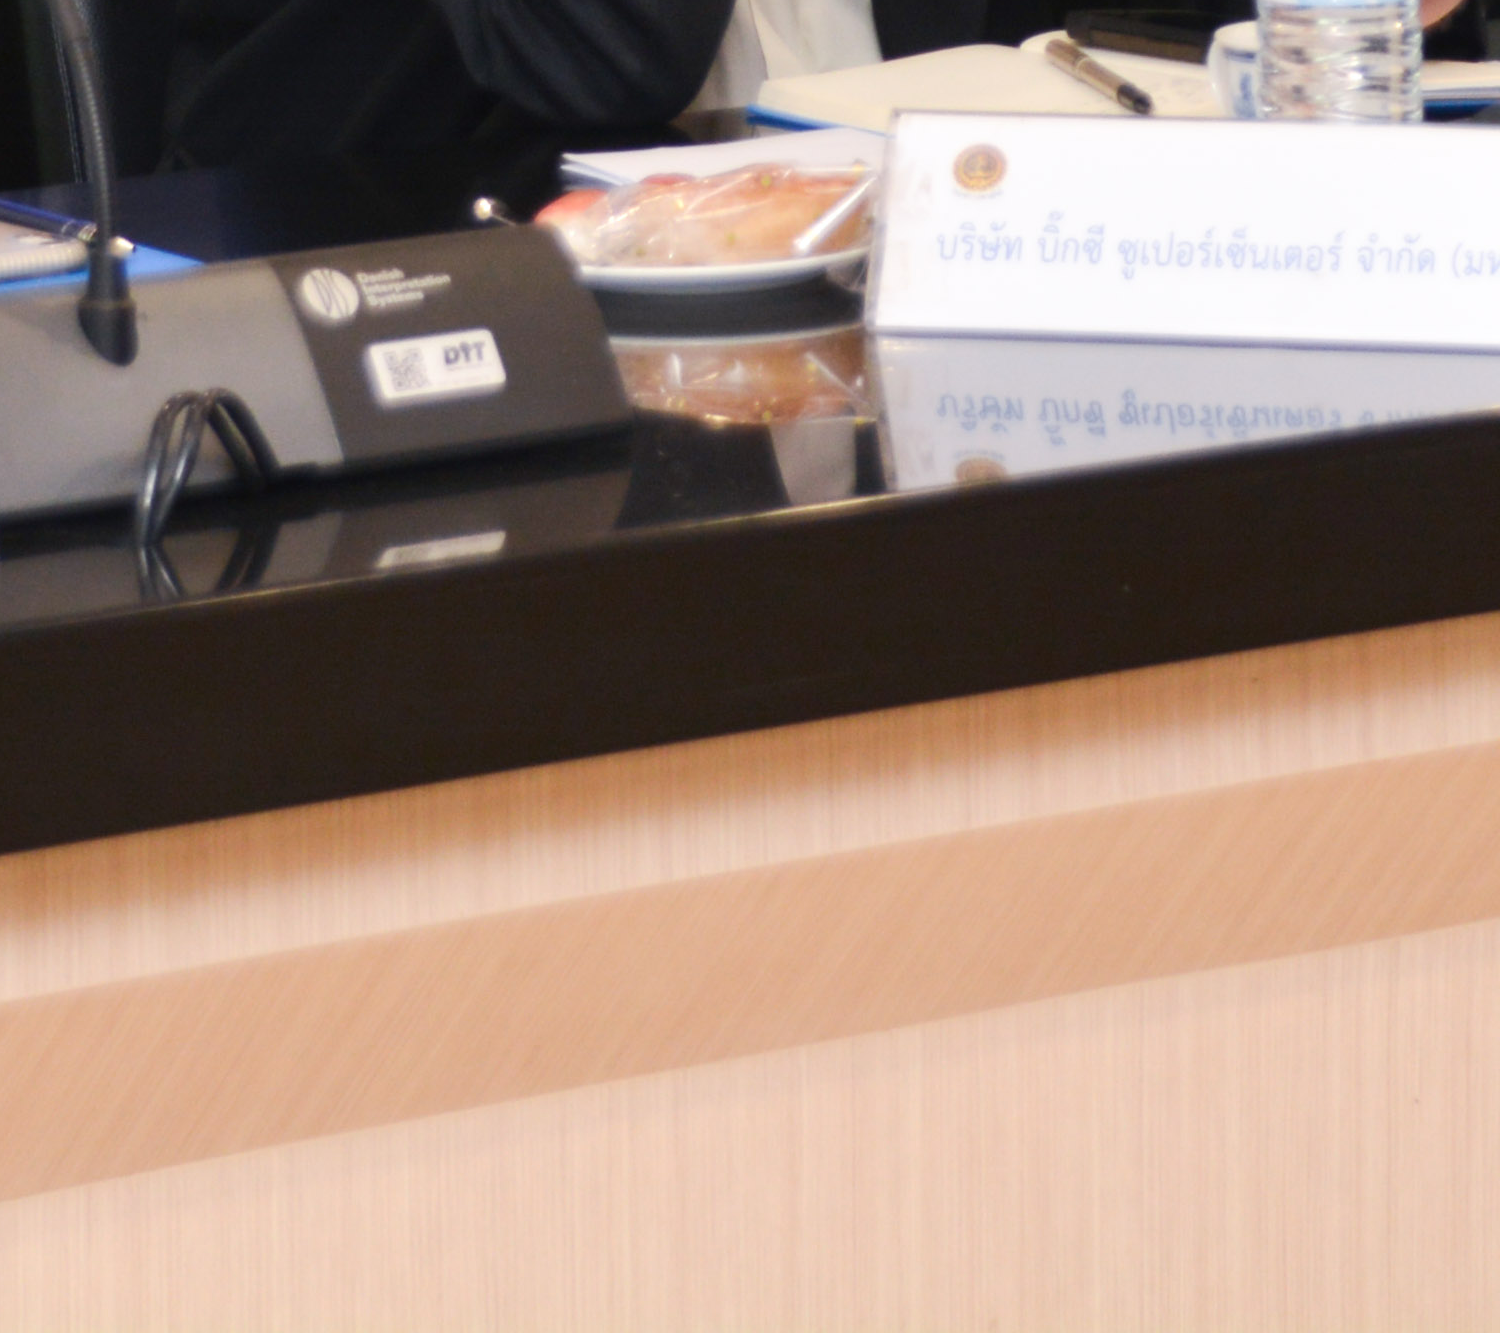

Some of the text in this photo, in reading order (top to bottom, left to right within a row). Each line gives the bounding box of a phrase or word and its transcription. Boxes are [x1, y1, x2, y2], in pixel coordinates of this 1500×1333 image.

[936, 220, 1024, 263] บริษัท
[1356, 231, 1437, 275] จำกัด
